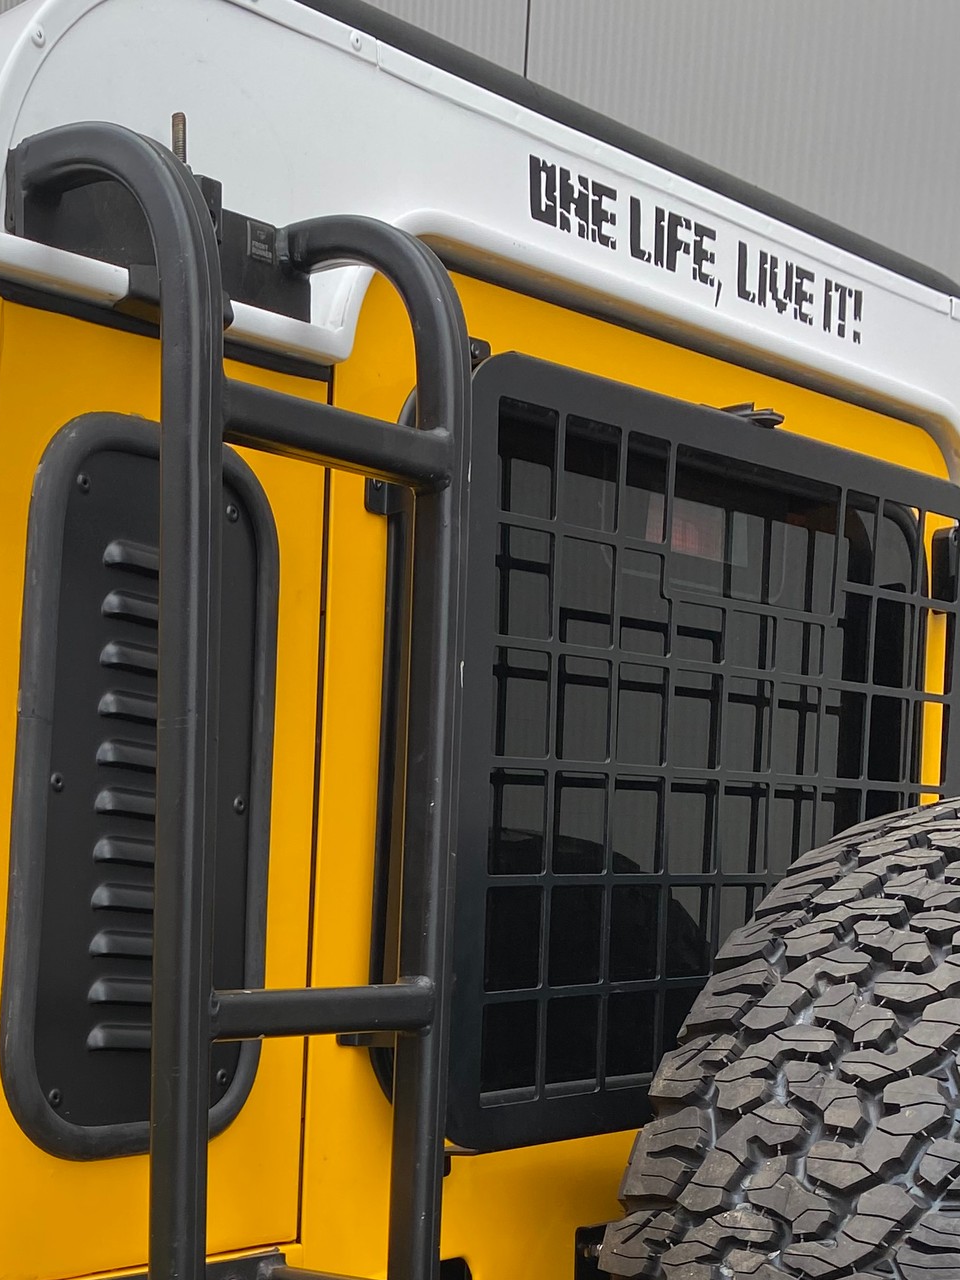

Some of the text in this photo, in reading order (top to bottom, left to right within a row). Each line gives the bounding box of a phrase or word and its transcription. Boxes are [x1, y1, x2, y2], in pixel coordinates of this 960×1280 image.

[529, 153, 865, 345] ONE LIFE, LIVE IT!
